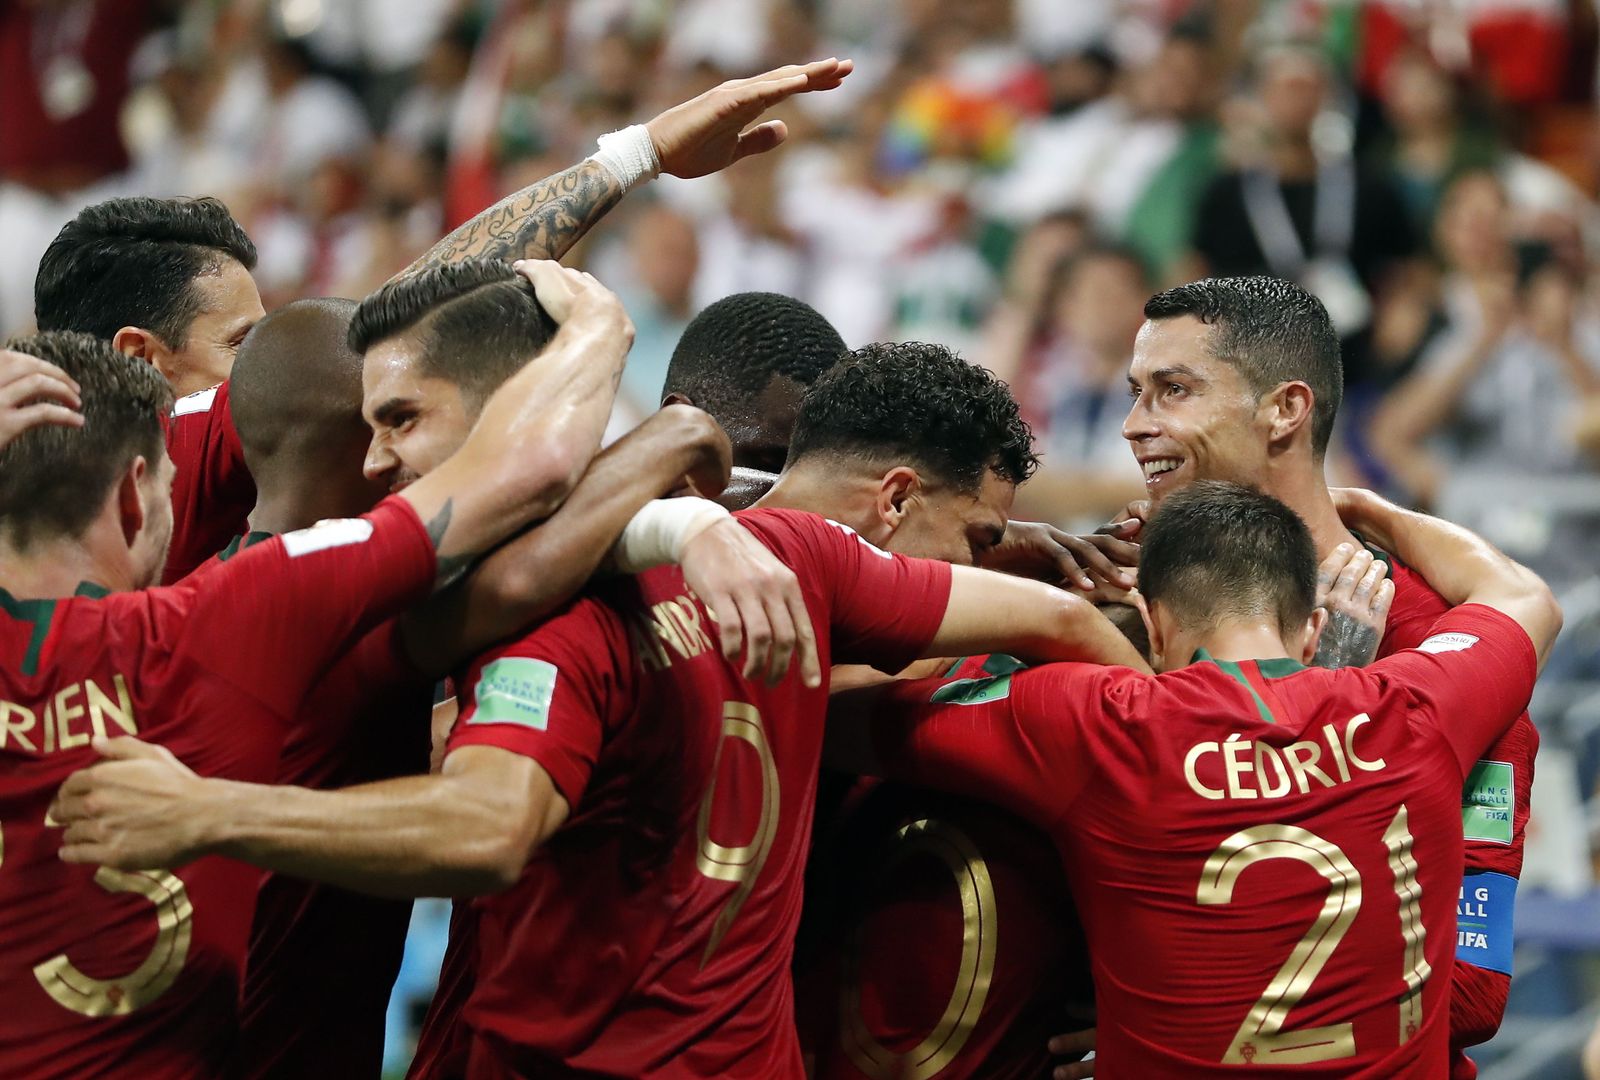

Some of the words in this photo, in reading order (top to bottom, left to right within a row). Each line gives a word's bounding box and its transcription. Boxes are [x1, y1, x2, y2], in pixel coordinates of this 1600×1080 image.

[636, 582, 719, 673] ANDR
[0, 674, 138, 752] RIEN
[1184, 713, 1386, 800] CÉDRIC
[1480, 786, 1508, 796] ING
[1486, 812, 1508, 821] FIFA
[697, 701, 780, 972] 9
[0, 814, 193, 1018] 3
[1196, 804, 1432, 1065] 21
[1457, 932, 1488, 949] IFA
